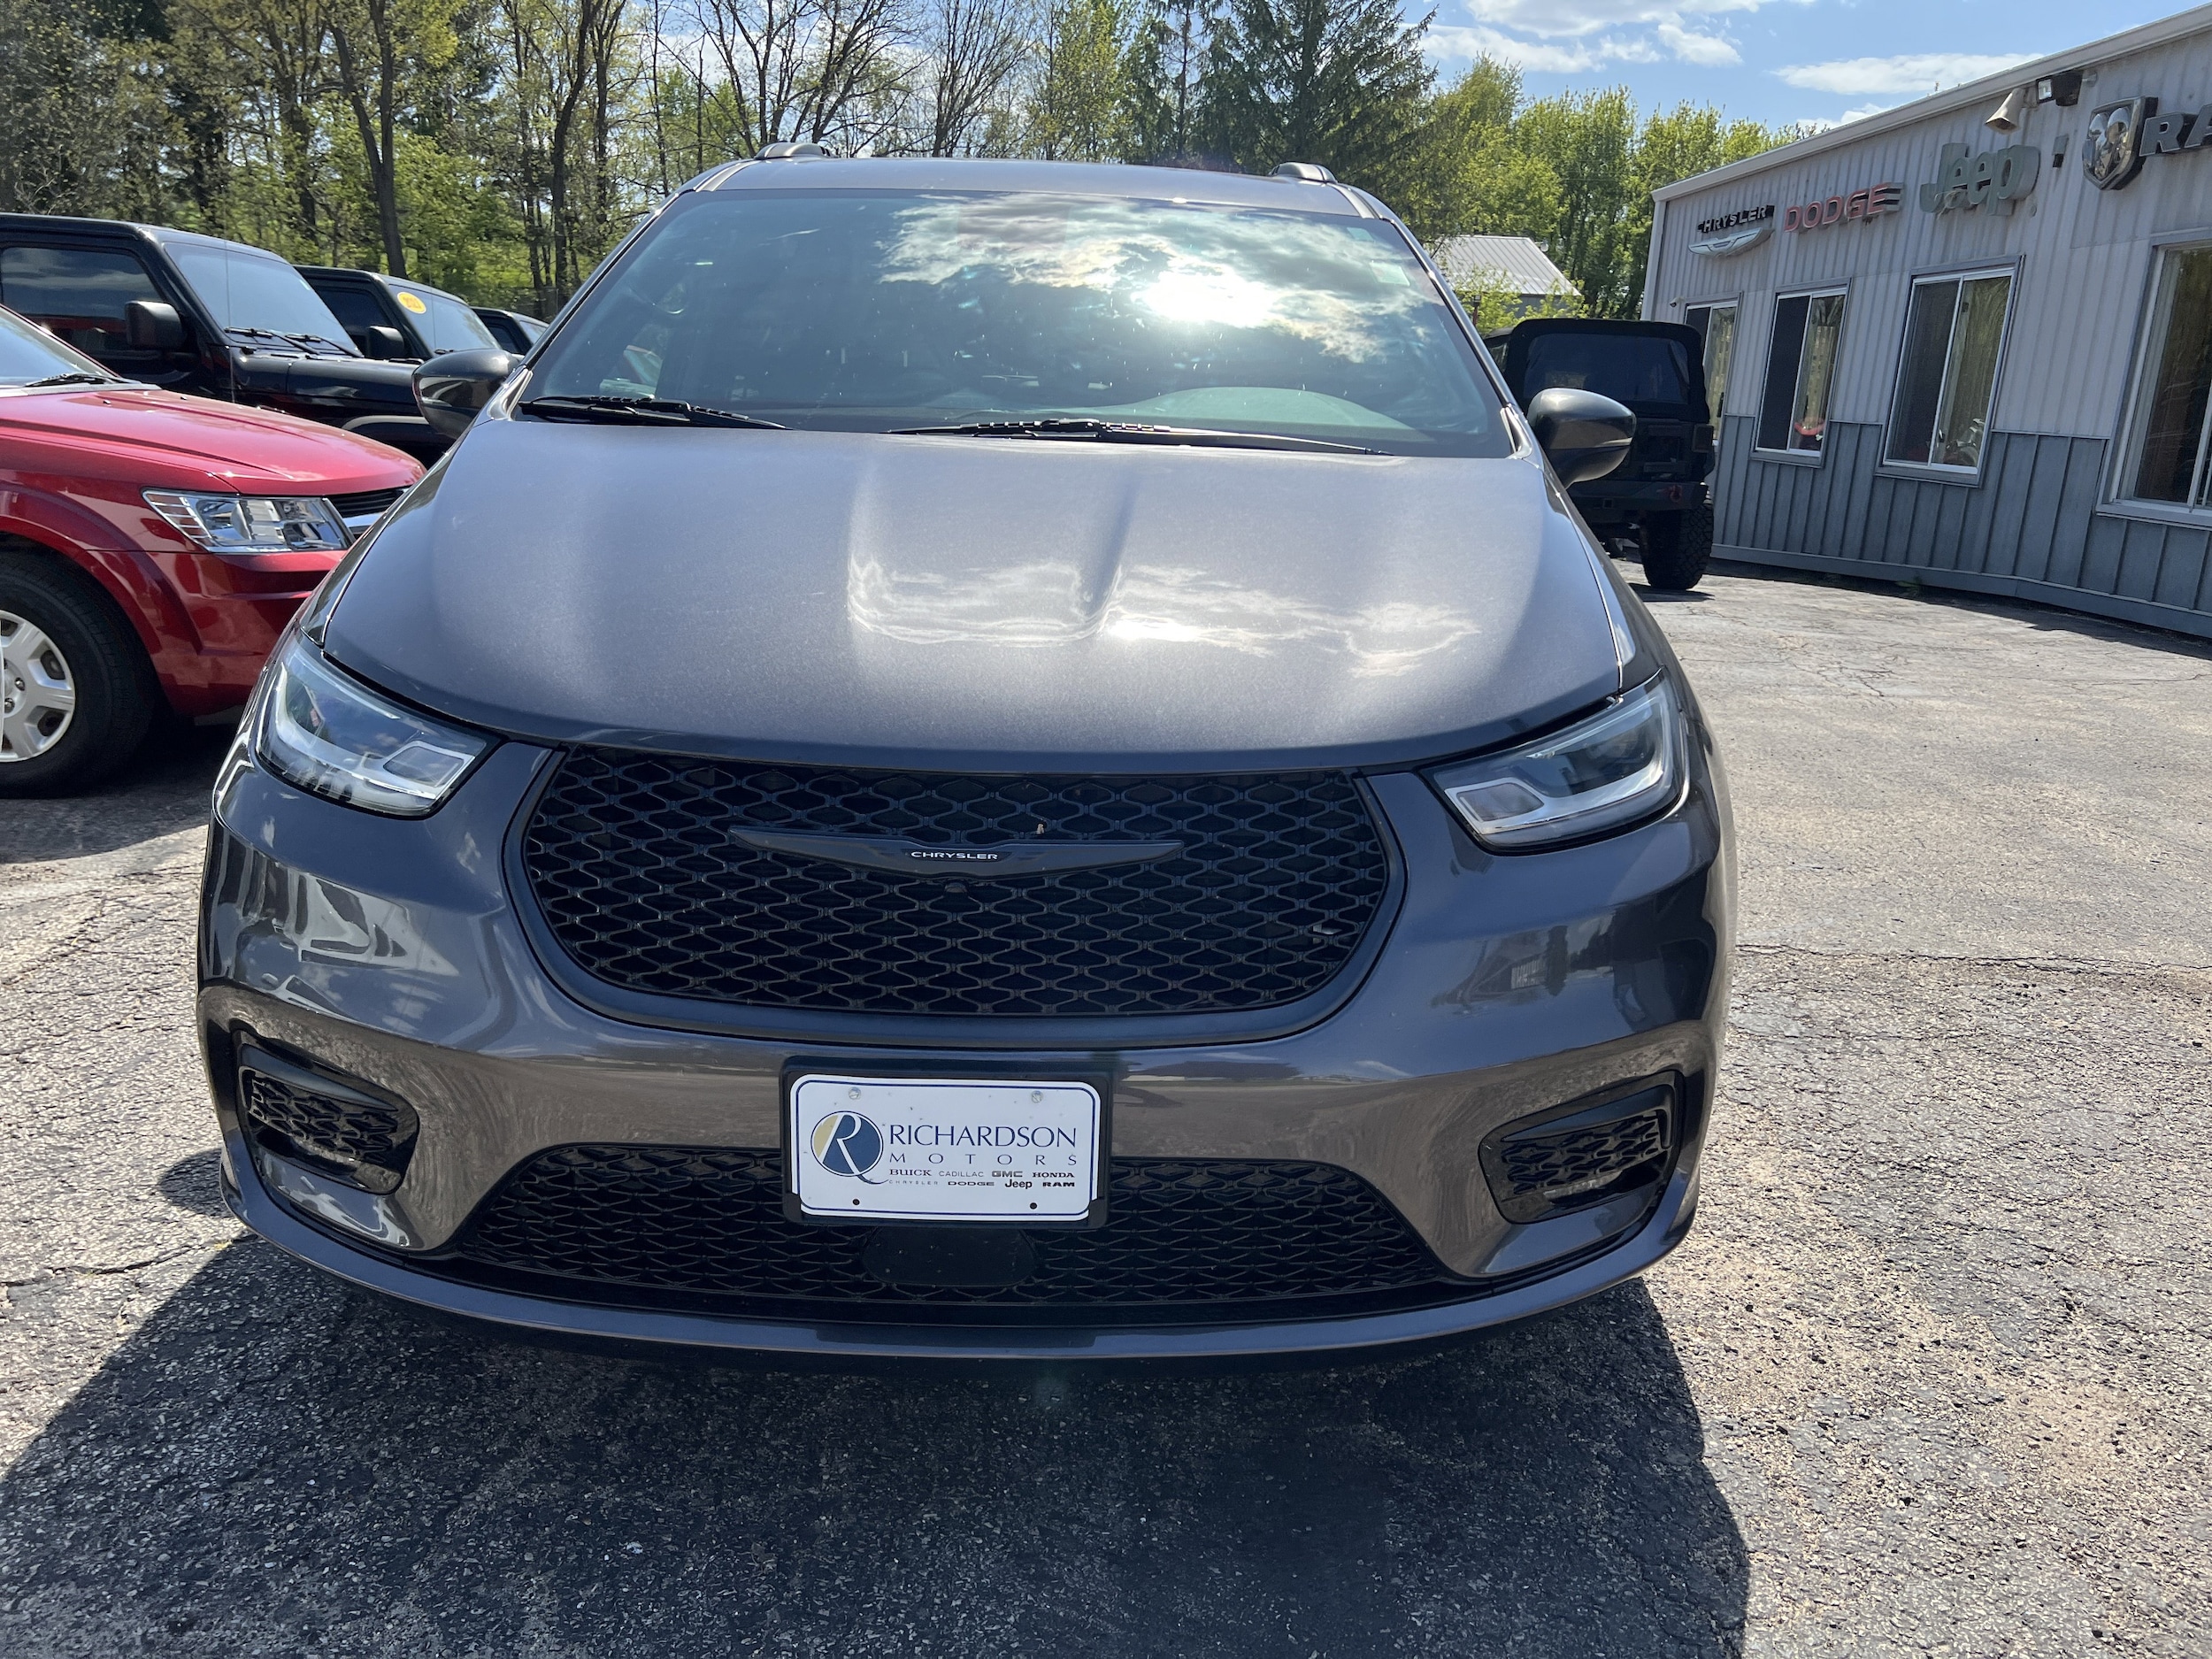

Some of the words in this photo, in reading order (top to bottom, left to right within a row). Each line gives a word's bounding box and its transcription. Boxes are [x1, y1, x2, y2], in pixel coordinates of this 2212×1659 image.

[1919, 142, 2039, 216] Jeep
[1783, 182, 1901, 233] DODGE
[910, 851, 999, 860] CHRYSLER
[889, 1125, 1077, 1148] RICHARDSON
[889, 1153, 1077, 1166] MOTORS
[1004, 1179, 1033, 1189] Jeep
